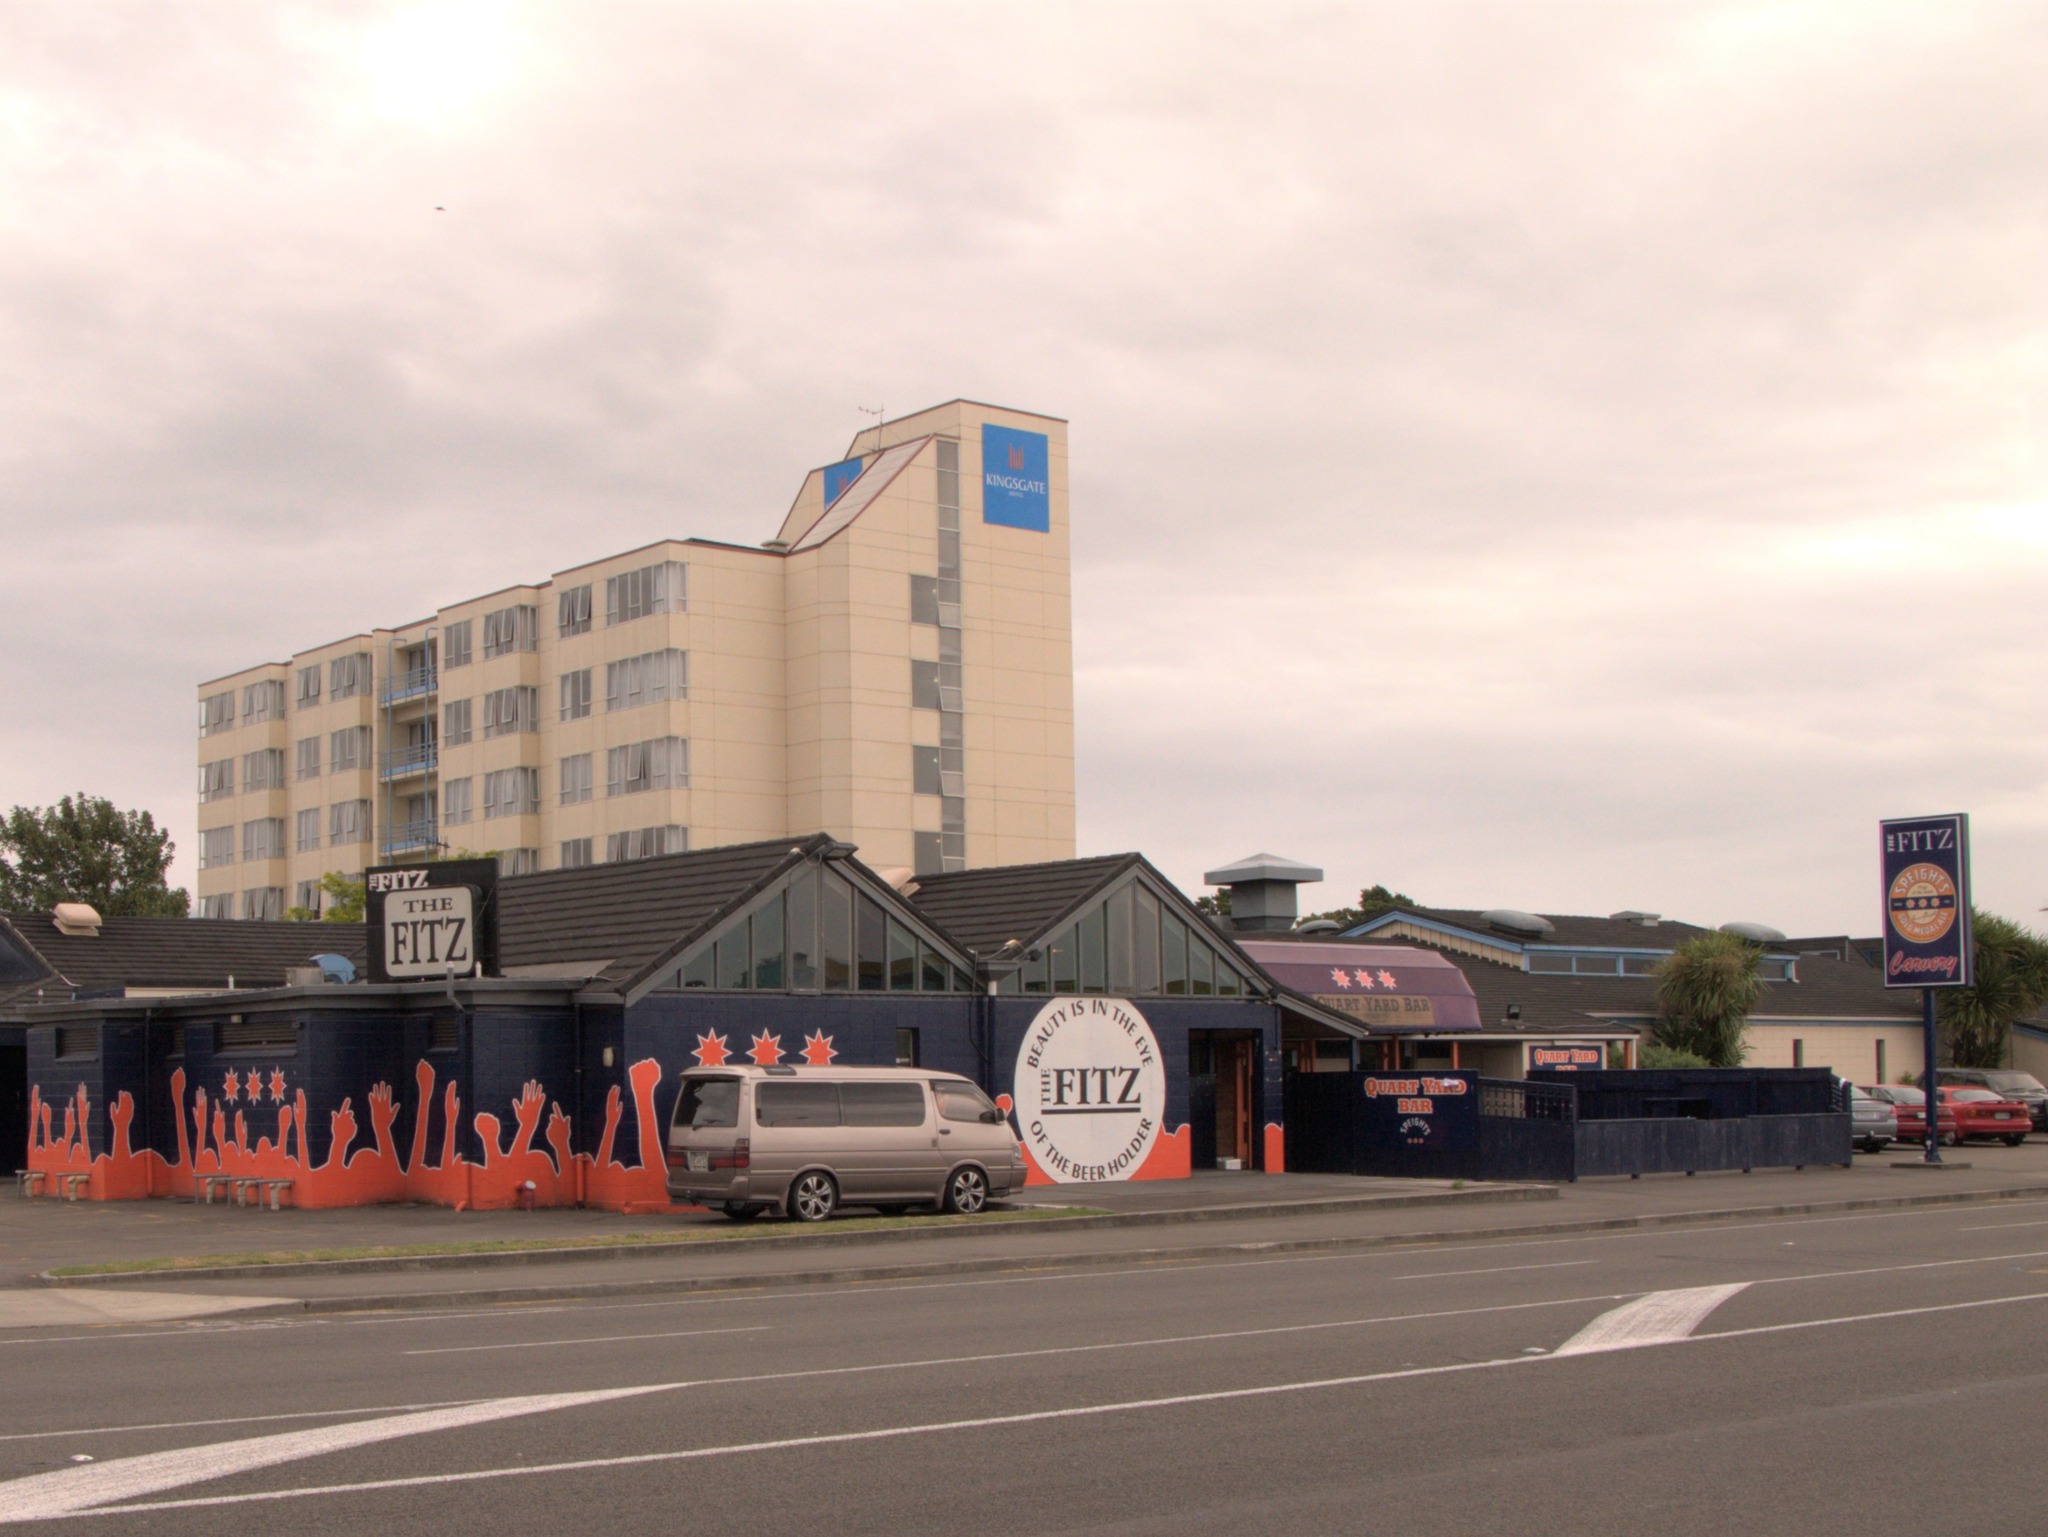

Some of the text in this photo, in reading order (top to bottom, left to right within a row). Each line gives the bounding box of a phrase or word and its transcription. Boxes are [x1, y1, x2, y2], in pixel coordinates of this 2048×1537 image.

[986, 473, 1046, 494] KINGSGATE
[1887, 828, 1953, 853] THE FITZ
[369, 870, 429, 892] THE FITZ
[403, 898, 453, 913] THE
[391, 917, 467, 965] FITZ
[1889, 951, 1957, 978] Carvery
[1364, 997, 1399, 1012] YARD
[1404, 998, 1430, 1012] BAR
[1027, 1000, 1154, 1069] BEAUTY IS IN THE EYE
[1534, 1048, 1598, 1066] QUART YARD
[1041, 1066, 1141, 1106] THE FITZ
[1364, 1077, 1419, 1098] QUART
[1397, 1098, 1433, 1114] BAR
[1030, 1117, 1152, 1181] OF THE BEER HOLDER
